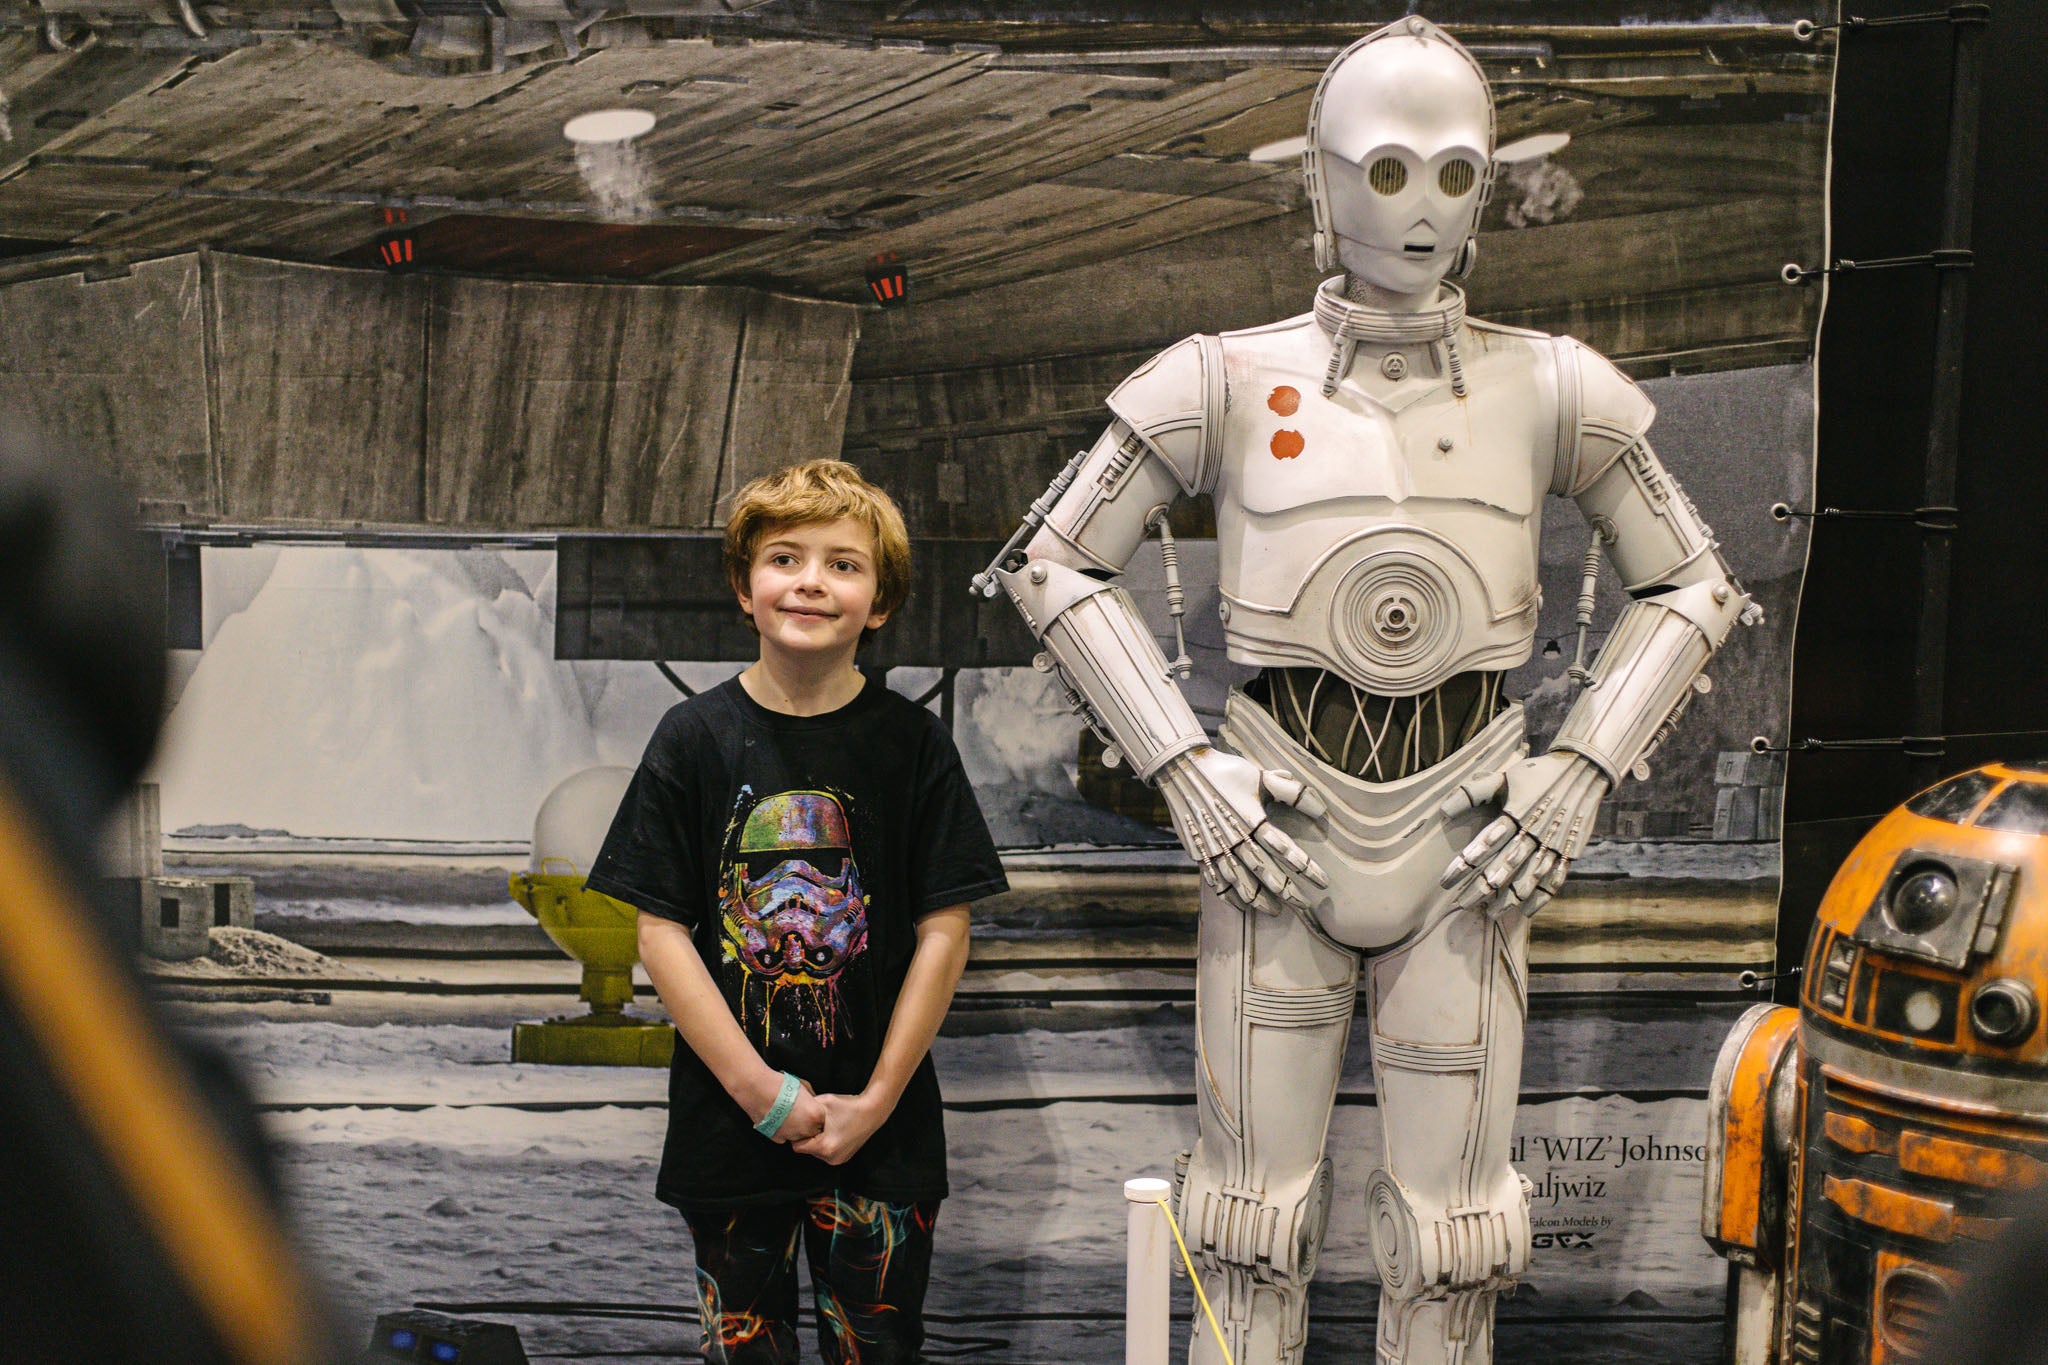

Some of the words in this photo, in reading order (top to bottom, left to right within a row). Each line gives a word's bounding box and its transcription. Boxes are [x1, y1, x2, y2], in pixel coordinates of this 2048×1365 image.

[1529, 1216, 1560, 1227] Falcon
[1562, 1215, 1599, 1228] Models
[1601, 1215, 1614, 1229] by
